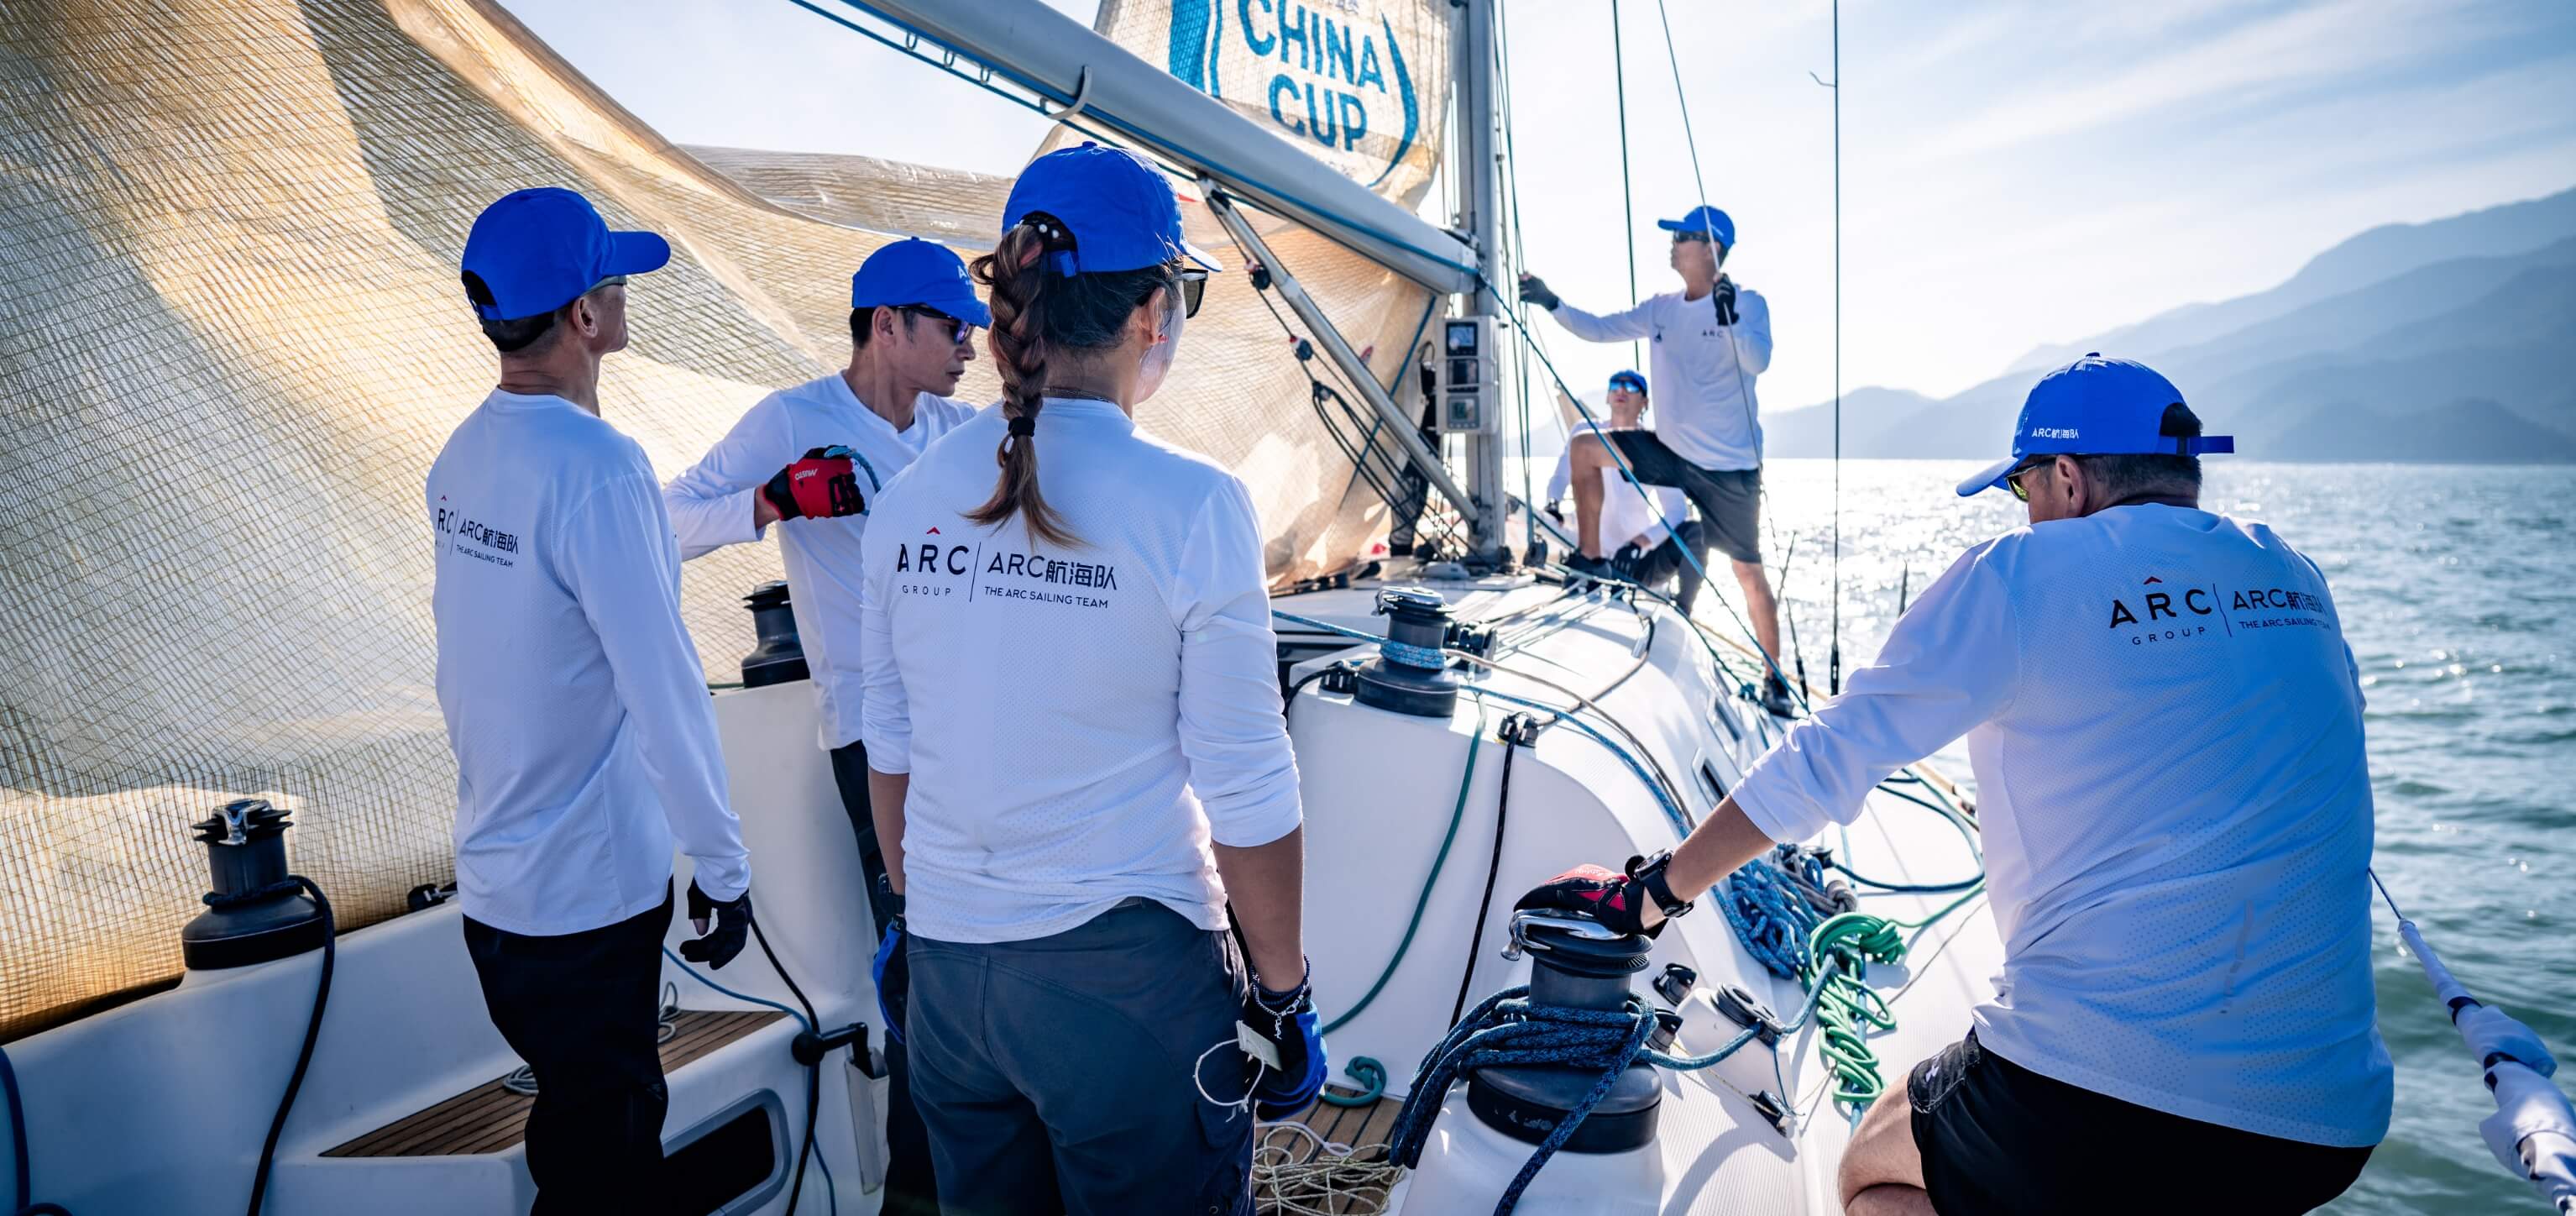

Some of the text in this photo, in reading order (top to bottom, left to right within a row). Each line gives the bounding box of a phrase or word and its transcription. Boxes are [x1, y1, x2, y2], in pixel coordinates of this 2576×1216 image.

[1238, 0, 1387, 94] CHINA
[1269, 74, 1367, 152] CUP
[437, 507, 454, 534] RC
[458, 518, 519, 554] ARC航海队
[456, 544, 464, 553] THE
[474, 550, 495, 563] SAILING
[496, 557, 514, 568] TEAM
[897, 543, 970, 575] ARC
[987, 551, 1118, 590] ARC航海队
[902, 584, 951, 597] GROUP
[984, 586, 1108, 609] THE ARC SAILING TEAM
[2109, 589, 2212, 628] ARC
[2132, 626, 2206, 646] GROUP
[2238, 621, 2260, 630] THE
[2262, 619, 2284, 628] ARC
[2285, 617, 2318, 627] SAILING
